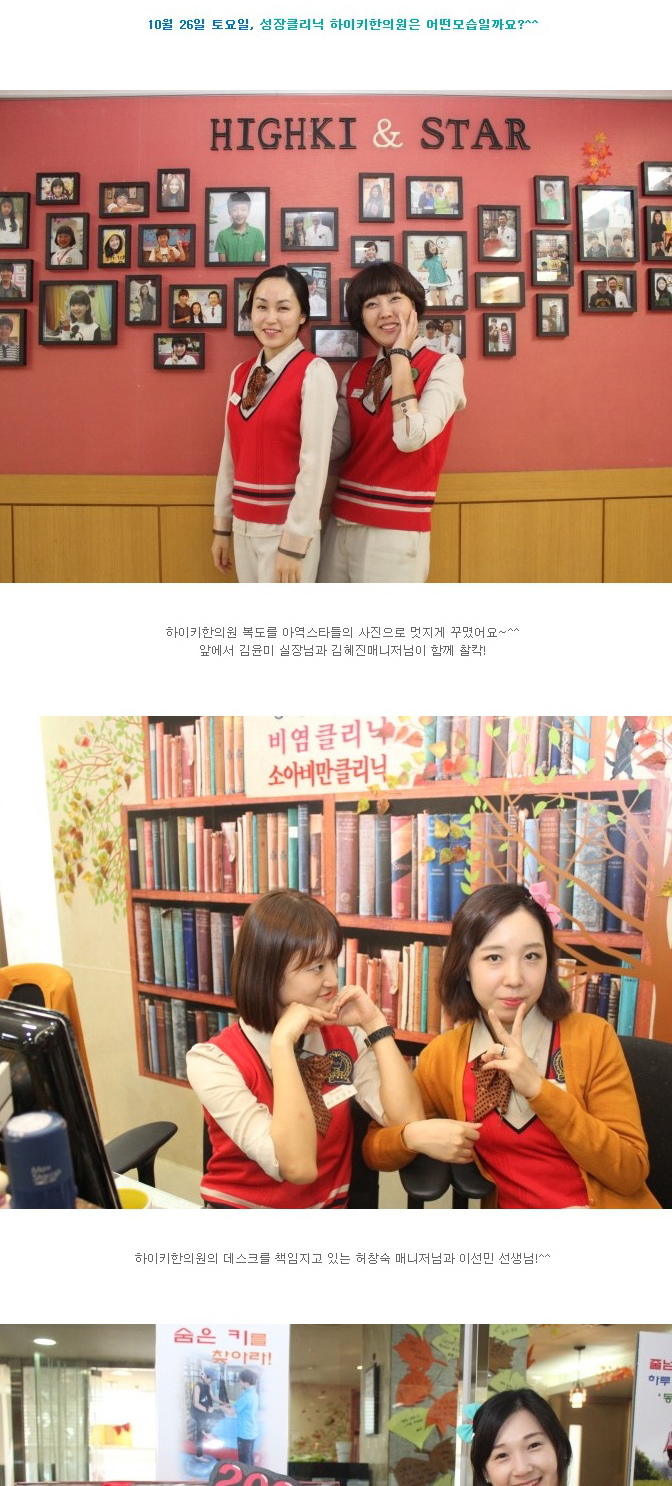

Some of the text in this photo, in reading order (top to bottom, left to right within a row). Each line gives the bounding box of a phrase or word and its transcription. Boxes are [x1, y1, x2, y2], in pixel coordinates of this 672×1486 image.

[210, 116, 531, 150] HIGHKI & STAR
[267, 716, 388, 755] 비염클리닉
[267, 753, 388, 788] 소아비만클리닉
[174, 1327, 267, 1347] 숨은 키를
[212, 1349, 273, 1366] 찾아라!
